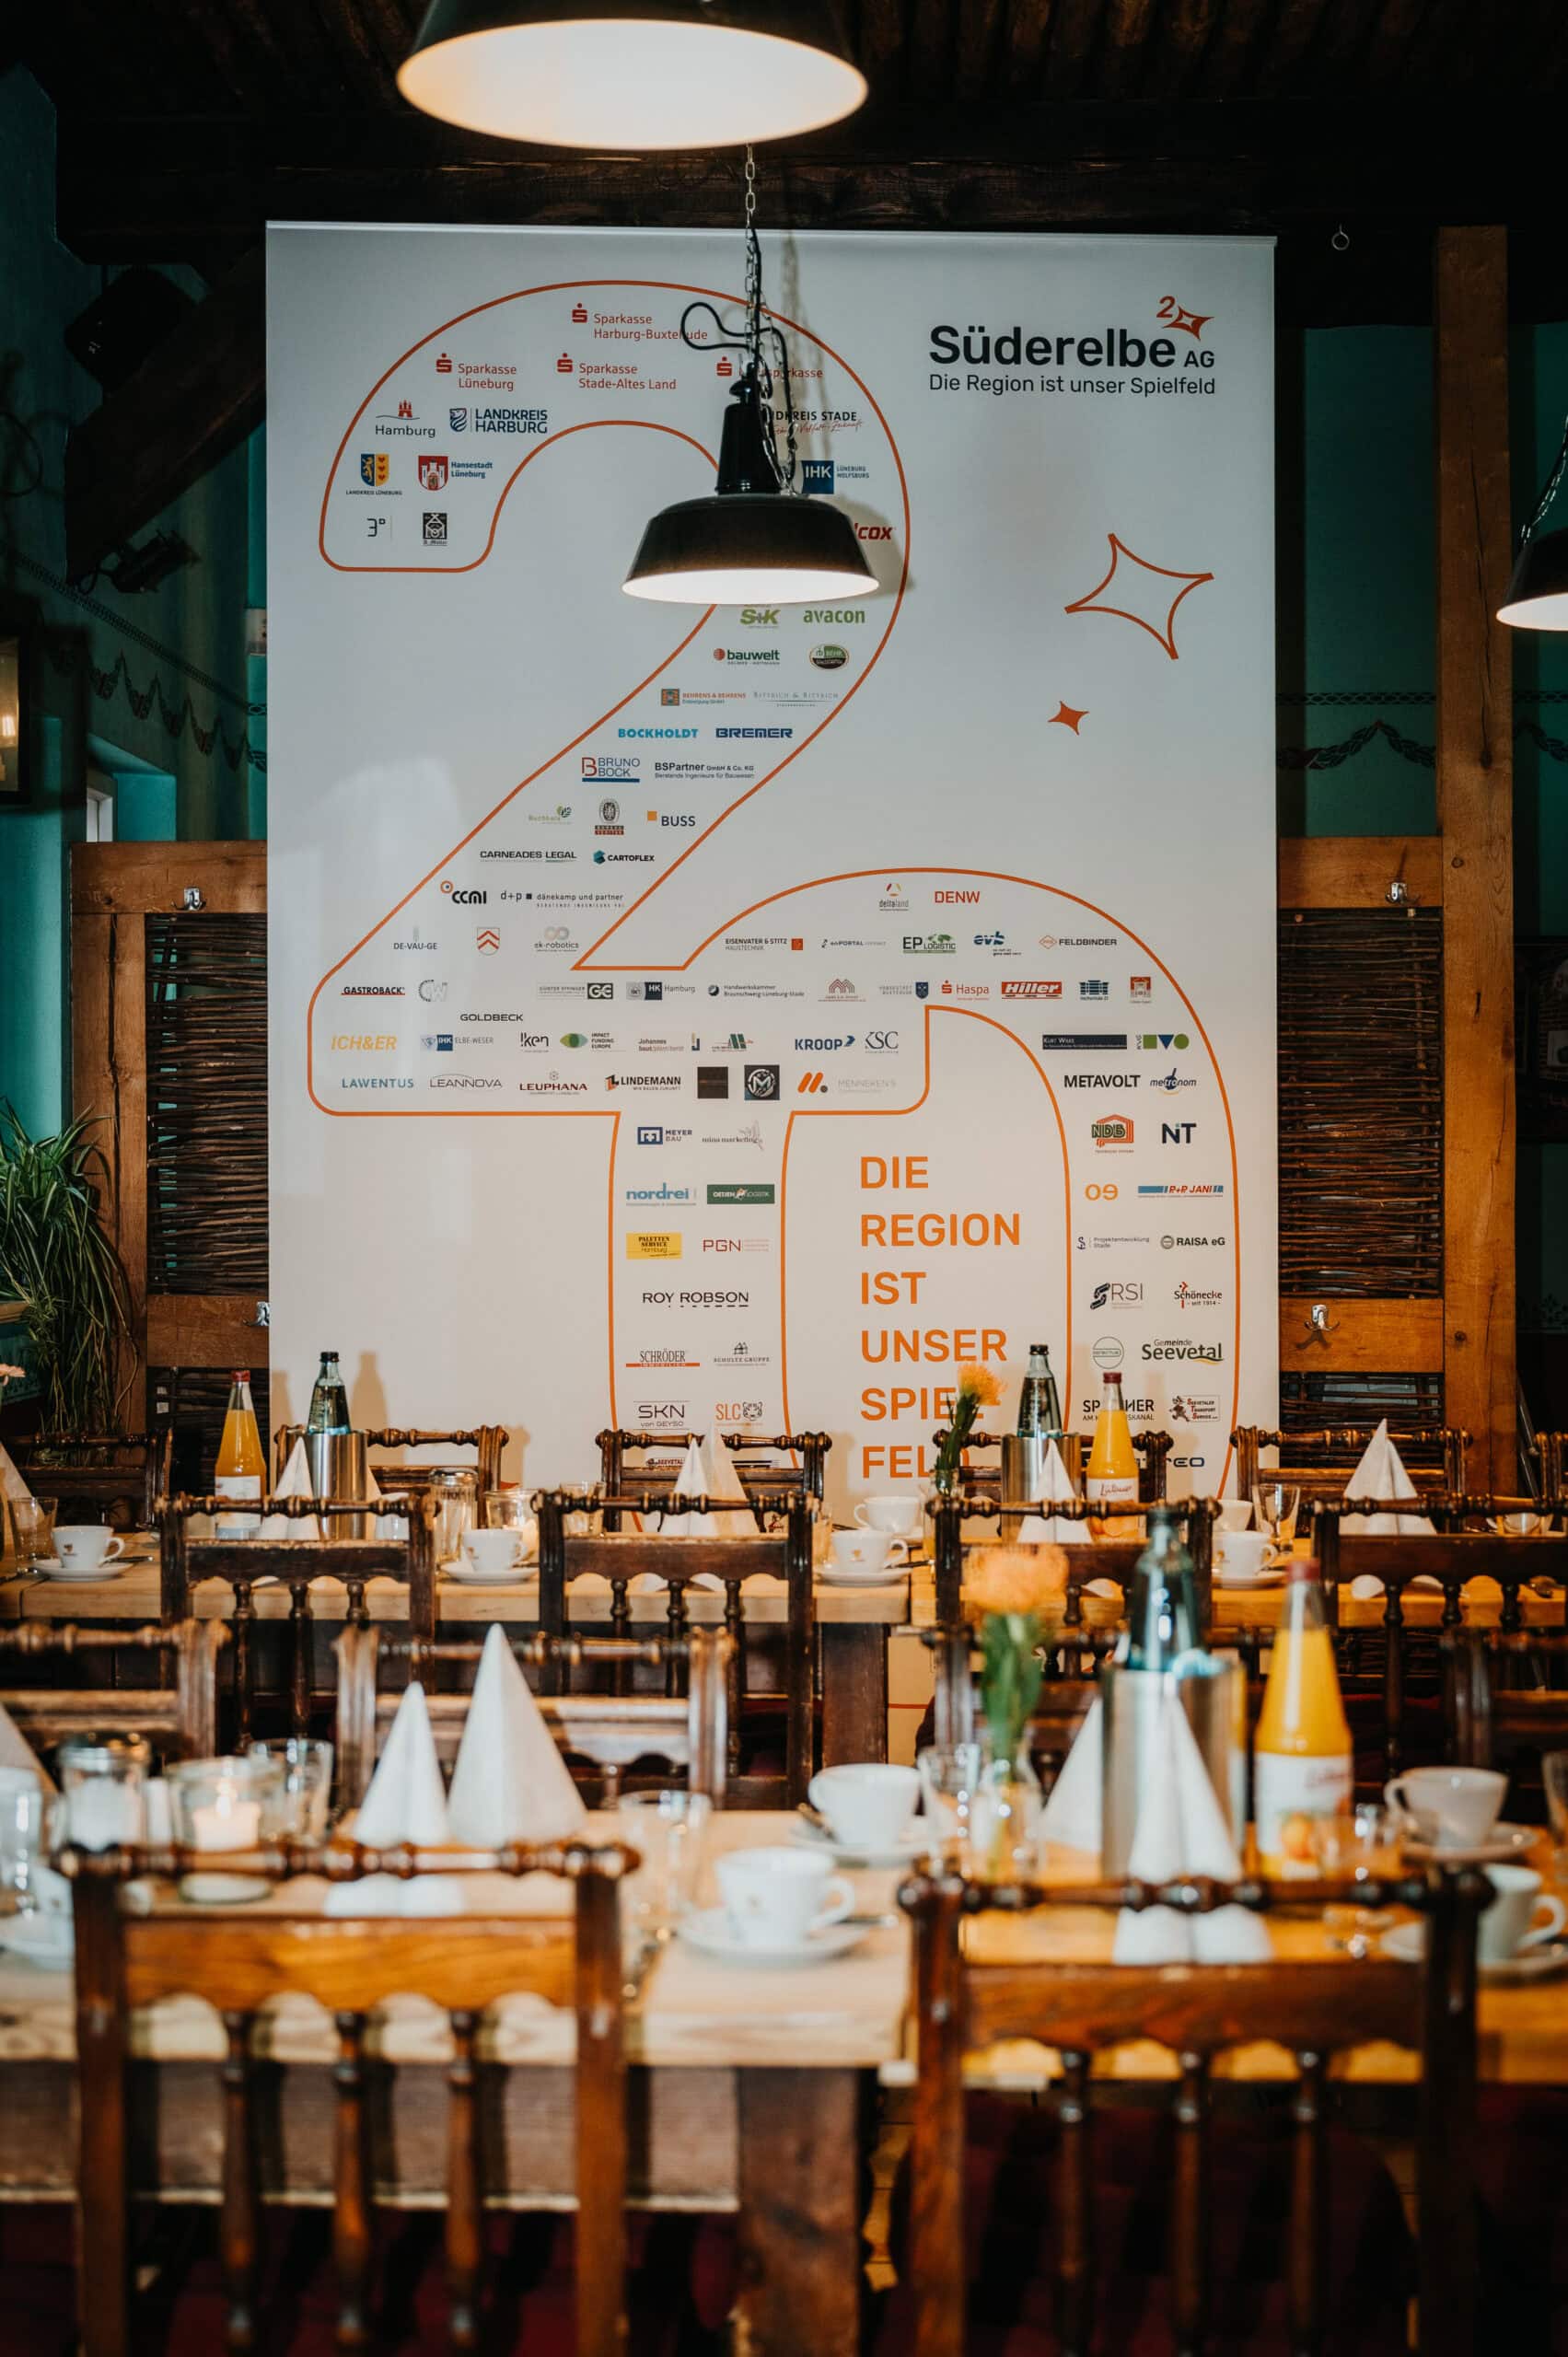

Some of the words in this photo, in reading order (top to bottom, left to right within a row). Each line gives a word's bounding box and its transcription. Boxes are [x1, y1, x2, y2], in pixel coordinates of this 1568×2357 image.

[594, 314, 653, 327] Sparkasse
[929, 325, 1177, 368] Süderelbe
[1184, 351, 1215, 368] AG
[458, 363, 517, 376] Sparkasse
[579, 364, 638, 377] Sparkasse
[459, 377, 515, 391] Lüneburg
[579, 378, 645, 390] Stade-Altes
[648, 378, 677, 389] Land
[929, 373, 960, 390] Die
[967, 374, 1034, 396] Region
[1040, 375, 1065, 392] ist
[1070, 378, 1125, 394] unser
[1130, 377, 1215, 398] Spielfeld
[475, 408, 548, 421] LANDKREIS
[821, 412, 857, 421] STADE
[376, 424, 436, 438] Hamburg
[475, 420, 548, 434] HARBURG
[451, 461, 494, 470] Hansestadt
[451, 470, 486, 479] Lüneburg
[806, 466, 832, 479] IHK
[803, 610, 865, 624] avacon
[727, 648, 781, 661] bauwelt
[618, 728, 699, 739] BOCKHOLDT
[715, 727, 793, 739] BREMER
[598, 758, 641, 768] BRUNO
[655, 762, 704, 772] BSPartner
[598, 768, 631, 777] BOCK
[661, 816, 696, 827] BUSS
[480, 851, 542, 859] CARNEADES
[545, 851, 576, 859] LEGAL
[608, 853, 655, 862] CARTOFLEX
[537, 892, 576, 902] dänekamp
[595, 894, 623, 902] partner
[935, 890, 981, 904] DENW
[393, 942, 437, 950] DE-VAU-GE
[902, 936, 923, 950] EP
[1059, 938, 1117, 946] FELDBINDER
[343, 985, 403, 995] GASTROBACK
[956, 983, 990, 996] Haspa
[1005, 981, 1060, 994] Hiller
[459, 1013, 524, 1022] GOLDBECK
[331, 1035, 397, 1051] ICH&ER
[437, 1036, 453, 1045] IHK
[795, 1039, 843, 1051] KROOP
[342, 1077, 414, 1089] LAWENTUS
[429, 1077, 503, 1088] LEANNOVA
[519, 1082, 588, 1091] LEUPHANA
[621, 1075, 681, 1086] LINDEMANN
[1063, 1074, 1141, 1088] METAVOLT
[860, 1156, 929, 1189] DIE
[626, 1182, 689, 1200] nordrei
[860, 1213, 1021, 1247] REGION
[703, 1239, 741, 1252] PGN
[1176, 1237, 1208, 1247] RAISA
[1211, 1237, 1225, 1247] eG
[860, 1271, 928, 1305] IST
[1111, 1283, 1144, 1301] RSI
[643, 1293, 675, 1304] ROY
[679, 1292, 749, 1304] ROBSON
[1174, 1290, 1223, 1301] Schönecke
[861, 1329, 1008, 1364] UNSER
[1154, 1339, 1192, 1347] Gemeinde
[640, 1347, 686, 1363] SCHRÖDER
[1142, 1342, 1223, 1361] Seevetal
[637, 1404, 685, 1419] SKN
[715, 1403, 741, 1421] SLC
